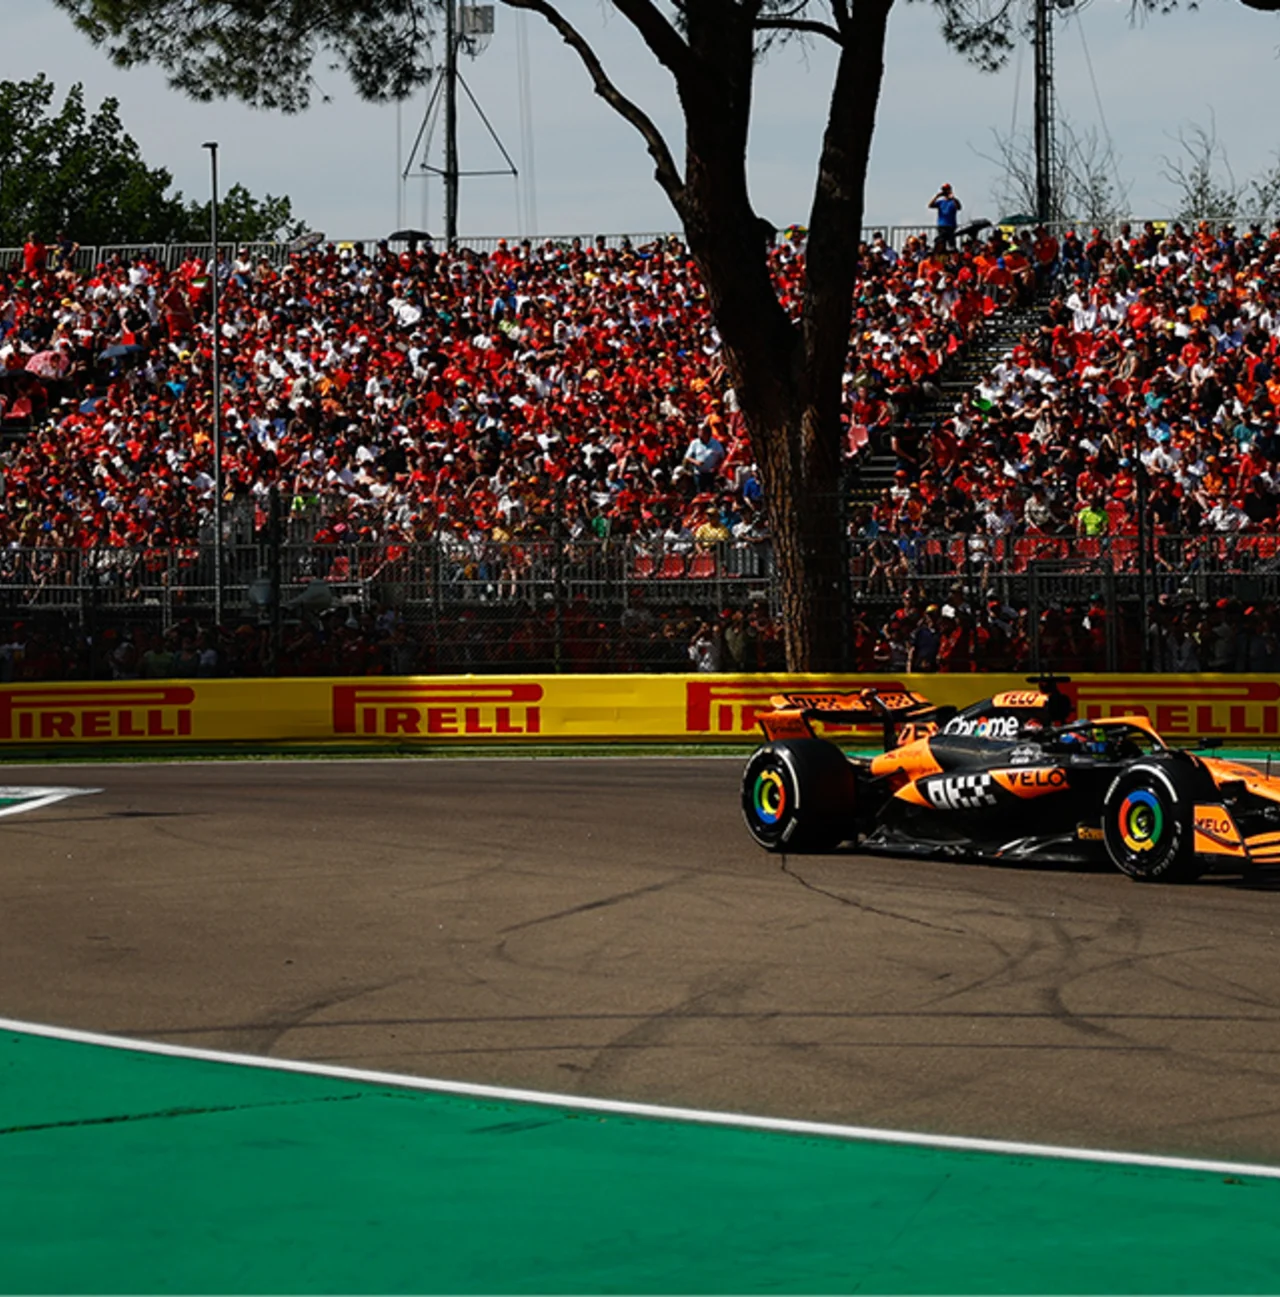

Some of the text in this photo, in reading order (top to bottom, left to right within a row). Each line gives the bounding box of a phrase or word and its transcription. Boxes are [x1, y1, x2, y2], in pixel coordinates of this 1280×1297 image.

[332, 683, 543, 734] PIRELLI
[1002, 692, 1039, 705] VELO
[943, 714, 1020, 737] Chrome
[1006, 769, 1066, 787] VELO
[928, 773, 998, 810] OKX
[1195, 818, 1231, 834] VELO
